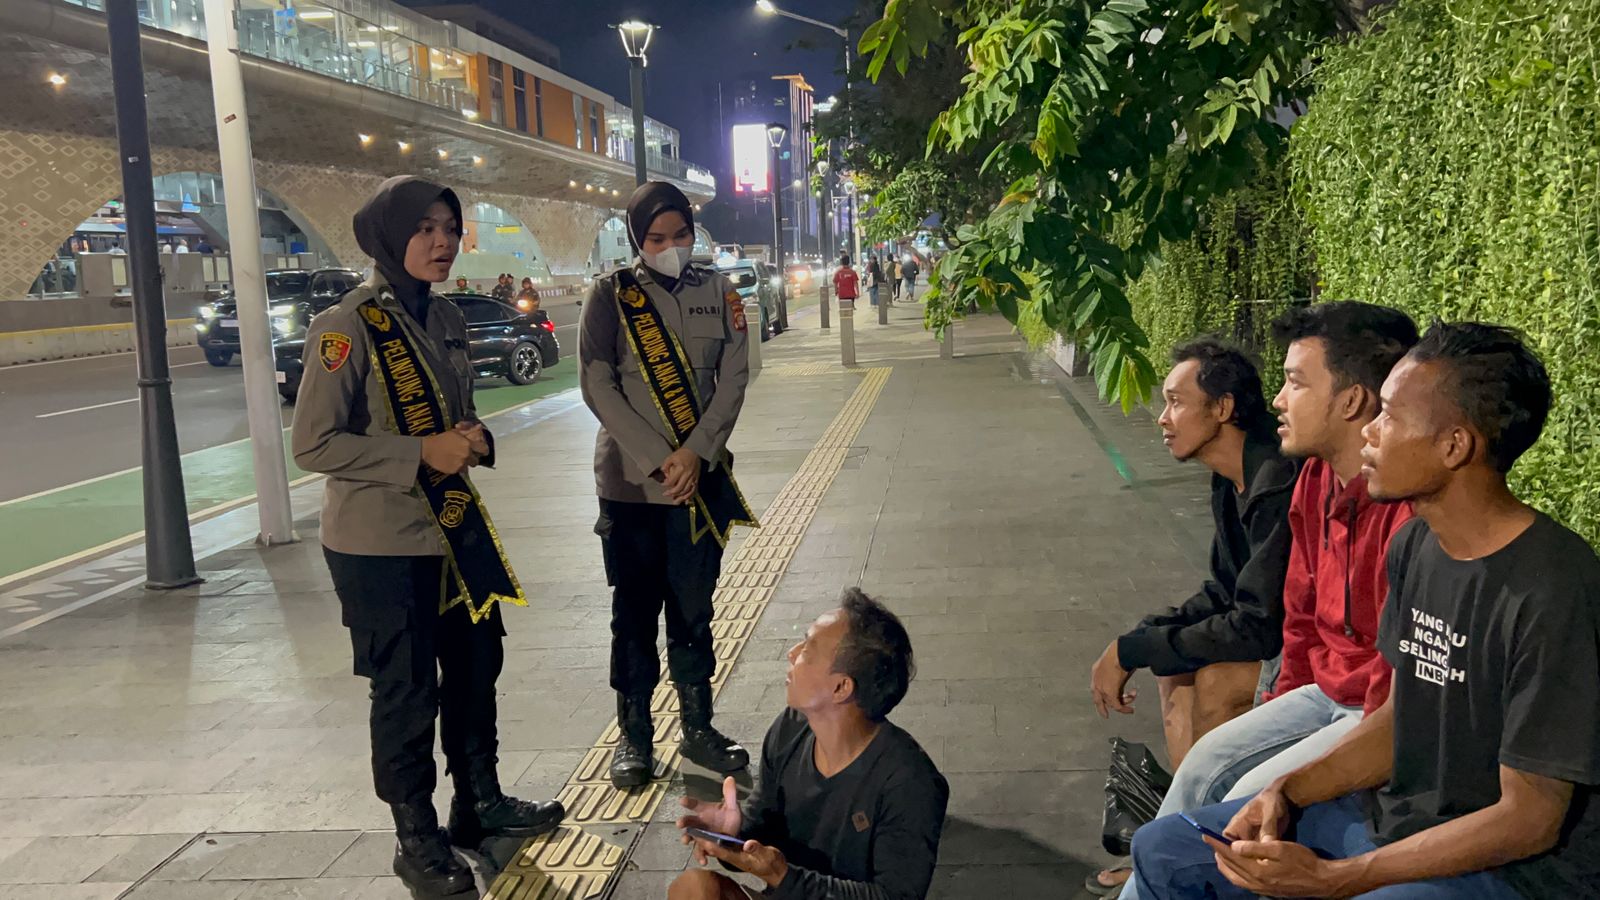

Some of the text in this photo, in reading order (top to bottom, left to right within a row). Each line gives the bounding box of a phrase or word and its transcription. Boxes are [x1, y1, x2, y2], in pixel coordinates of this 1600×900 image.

[689, 306, 720, 315] POLRI
[380, 338, 436, 437] PELINDUNG ANAK
[632, 312, 670, 363] PELINDUNG
[652, 361, 682, 391] ANAK
[668, 394, 696, 433] WANITA
[1412, 608, 1443, 632] YANG
